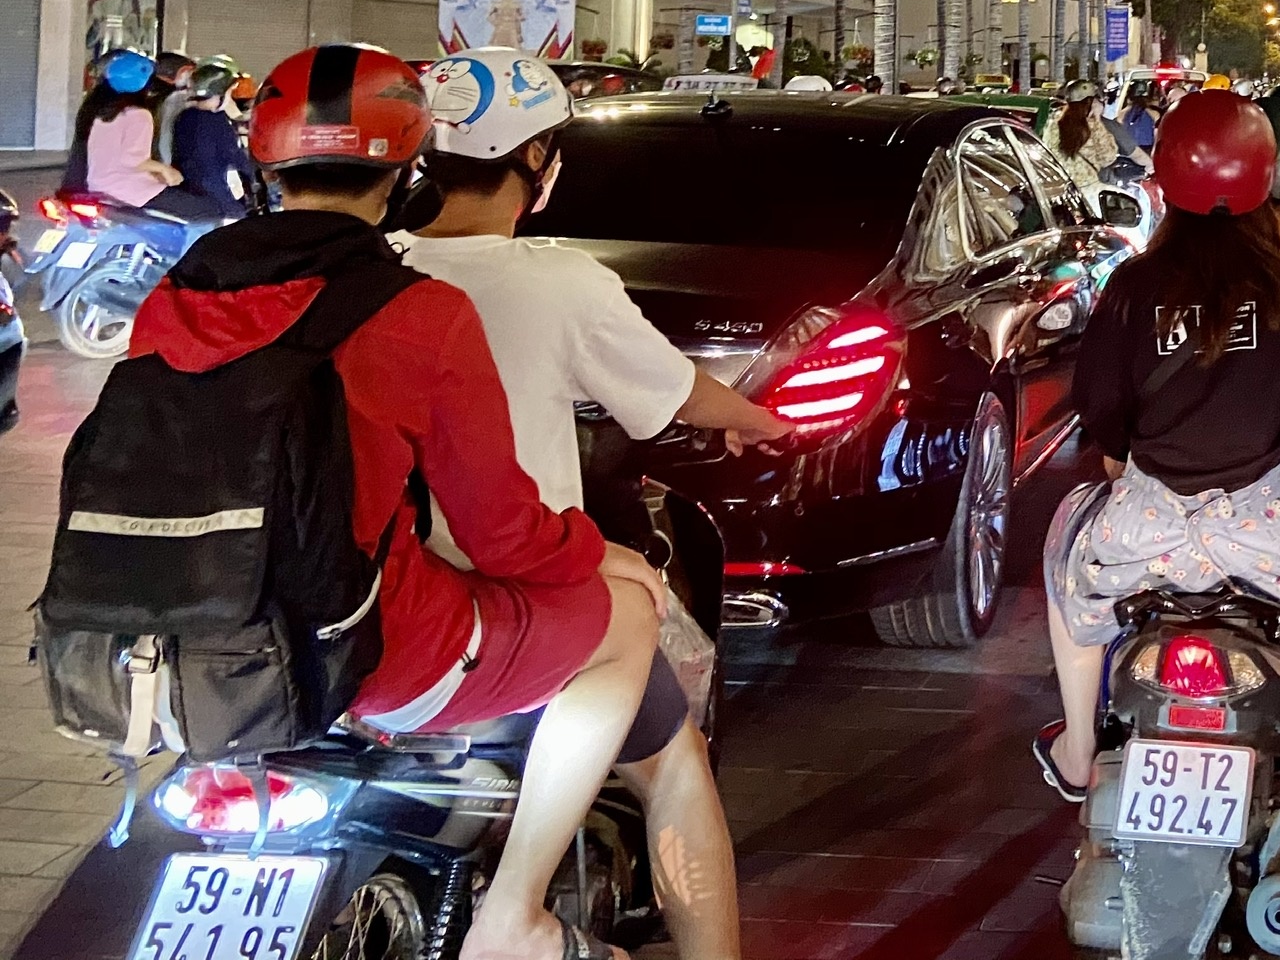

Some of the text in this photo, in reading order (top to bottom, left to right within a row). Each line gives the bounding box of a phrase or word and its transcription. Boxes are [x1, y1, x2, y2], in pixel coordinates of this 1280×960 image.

[1141, 749, 1233, 791] 59-T2
[1126, 792, 1237, 836] 492.47
[175, 866, 295, 917] 59-N1
